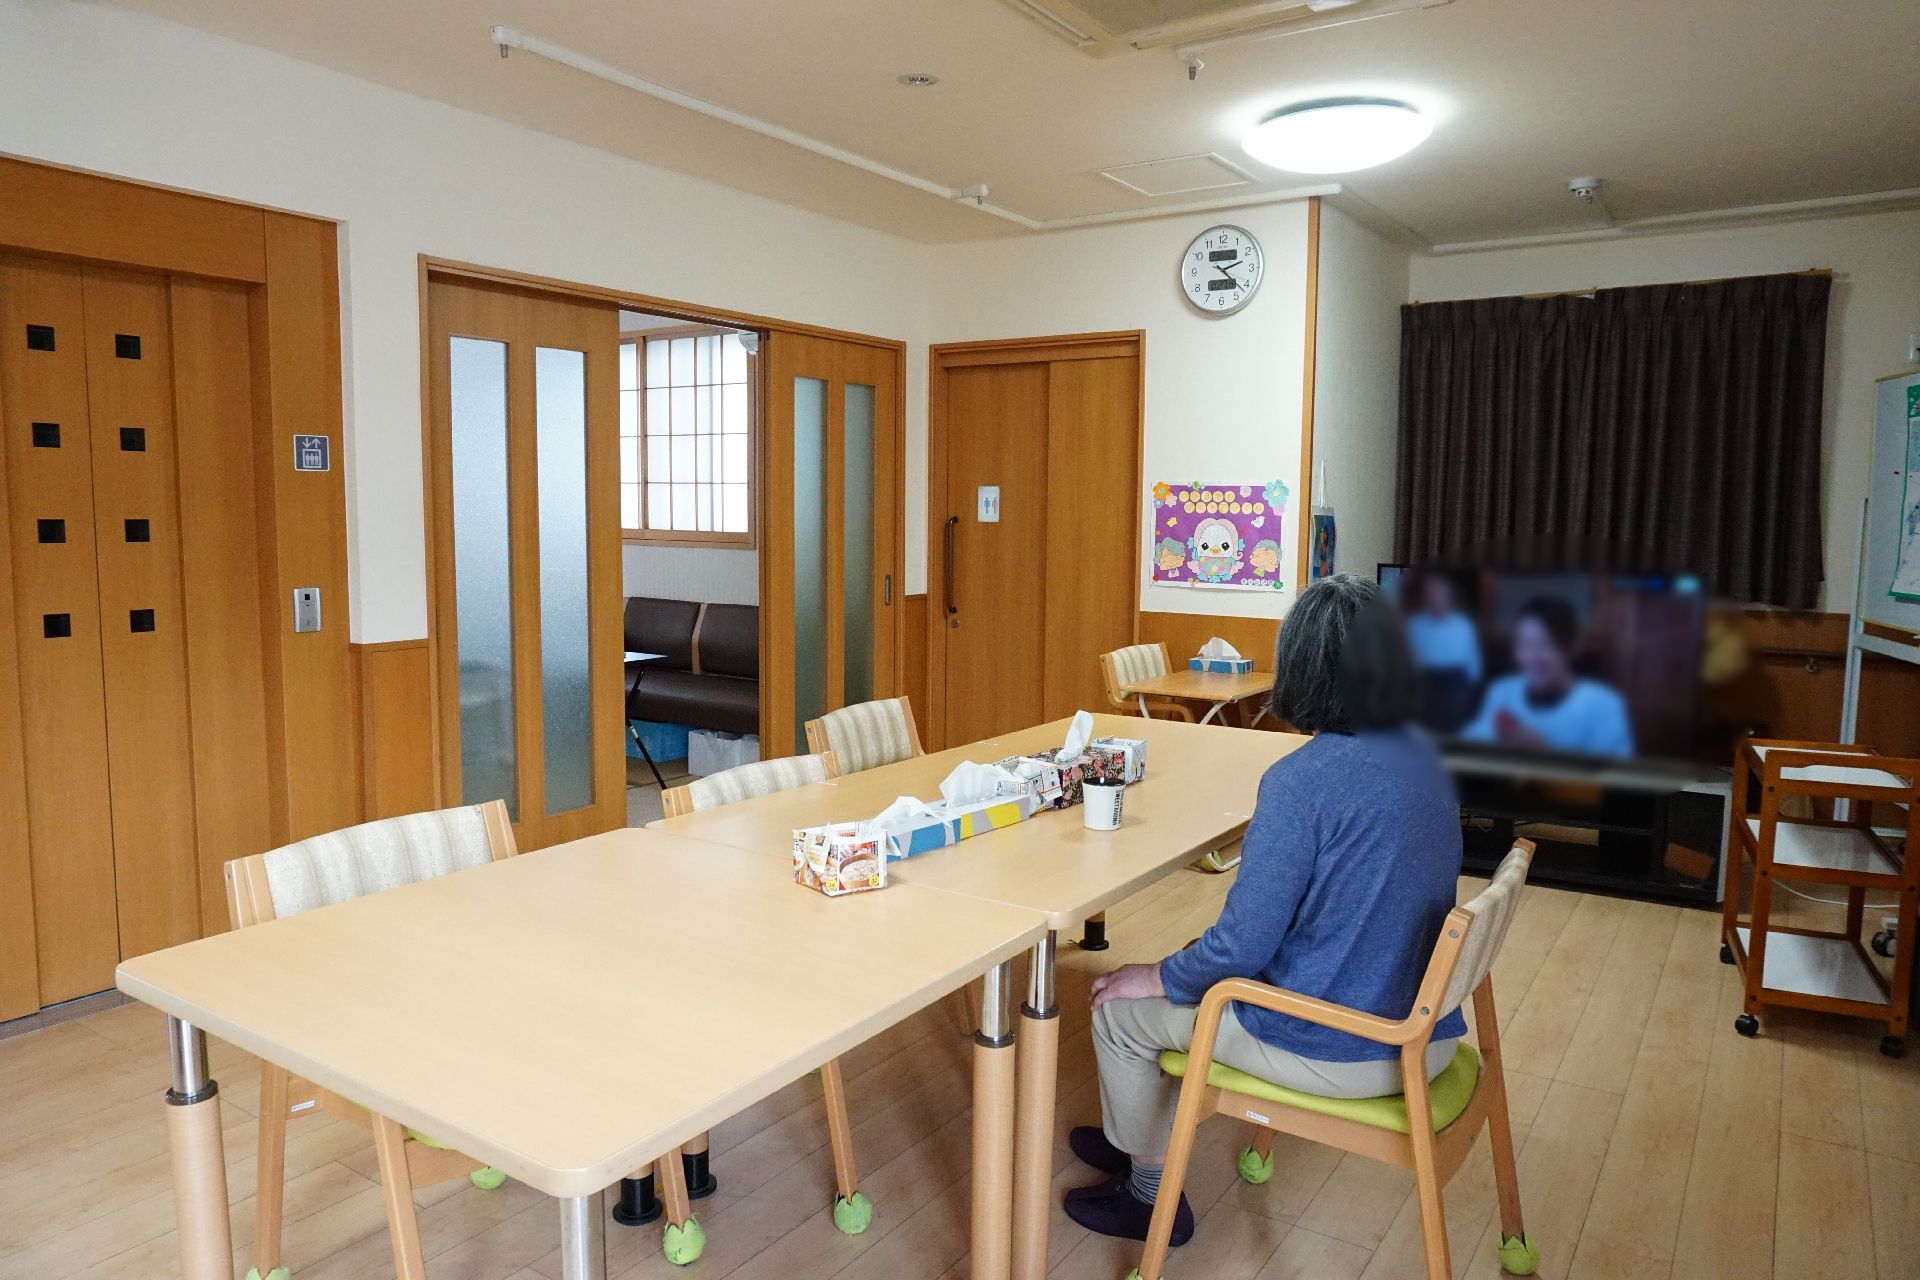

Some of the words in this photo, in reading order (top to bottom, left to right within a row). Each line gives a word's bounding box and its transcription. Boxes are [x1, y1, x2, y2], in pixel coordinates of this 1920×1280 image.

[1219, 234, 1228, 244] 12
[1206, 240, 1213, 249] 11
[1195, 251, 1204, 261] 10
[1244, 246, 1252, 256] 2
[1191, 267, 1198, 277] 9
[1248, 263, 1255, 273] 3
[1194, 283, 1201, 293] 8
[1243, 279, 1250, 289] 4
[1204, 293, 1211, 303] 7
[1218, 296, 1225, 306] 6
[1233, 291, 1240, 301] 5
